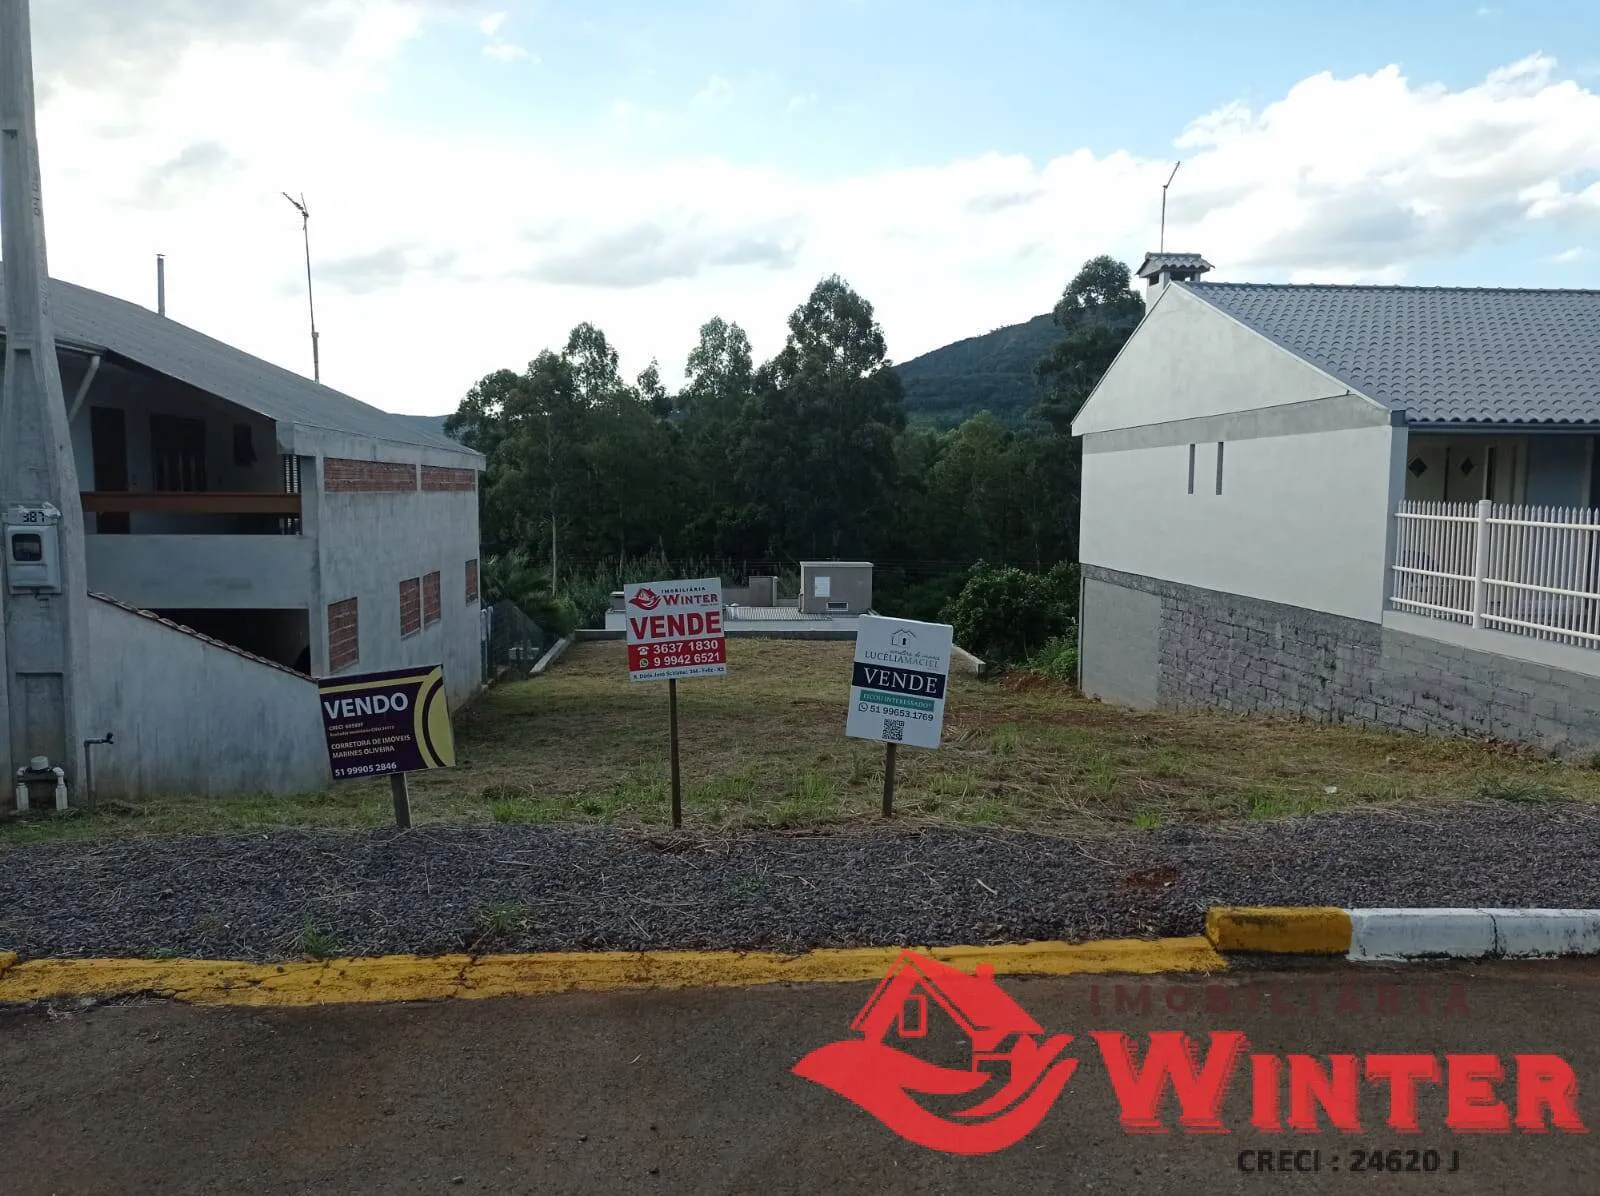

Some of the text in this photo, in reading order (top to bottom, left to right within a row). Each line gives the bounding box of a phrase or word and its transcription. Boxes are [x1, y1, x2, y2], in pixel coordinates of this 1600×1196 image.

[629, 611, 722, 640] VENDE
[653, 640, 718, 654] 3637 1830
[653, 652, 720, 667] 9 9942 6521
[863, 667, 938, 694] VENDE
[323, 692, 409, 719] VENDO
[870, 705, 880, 714] 51
[372, 736, 382, 745] DE
[335, 762, 397, 776] 51 99905 2846
